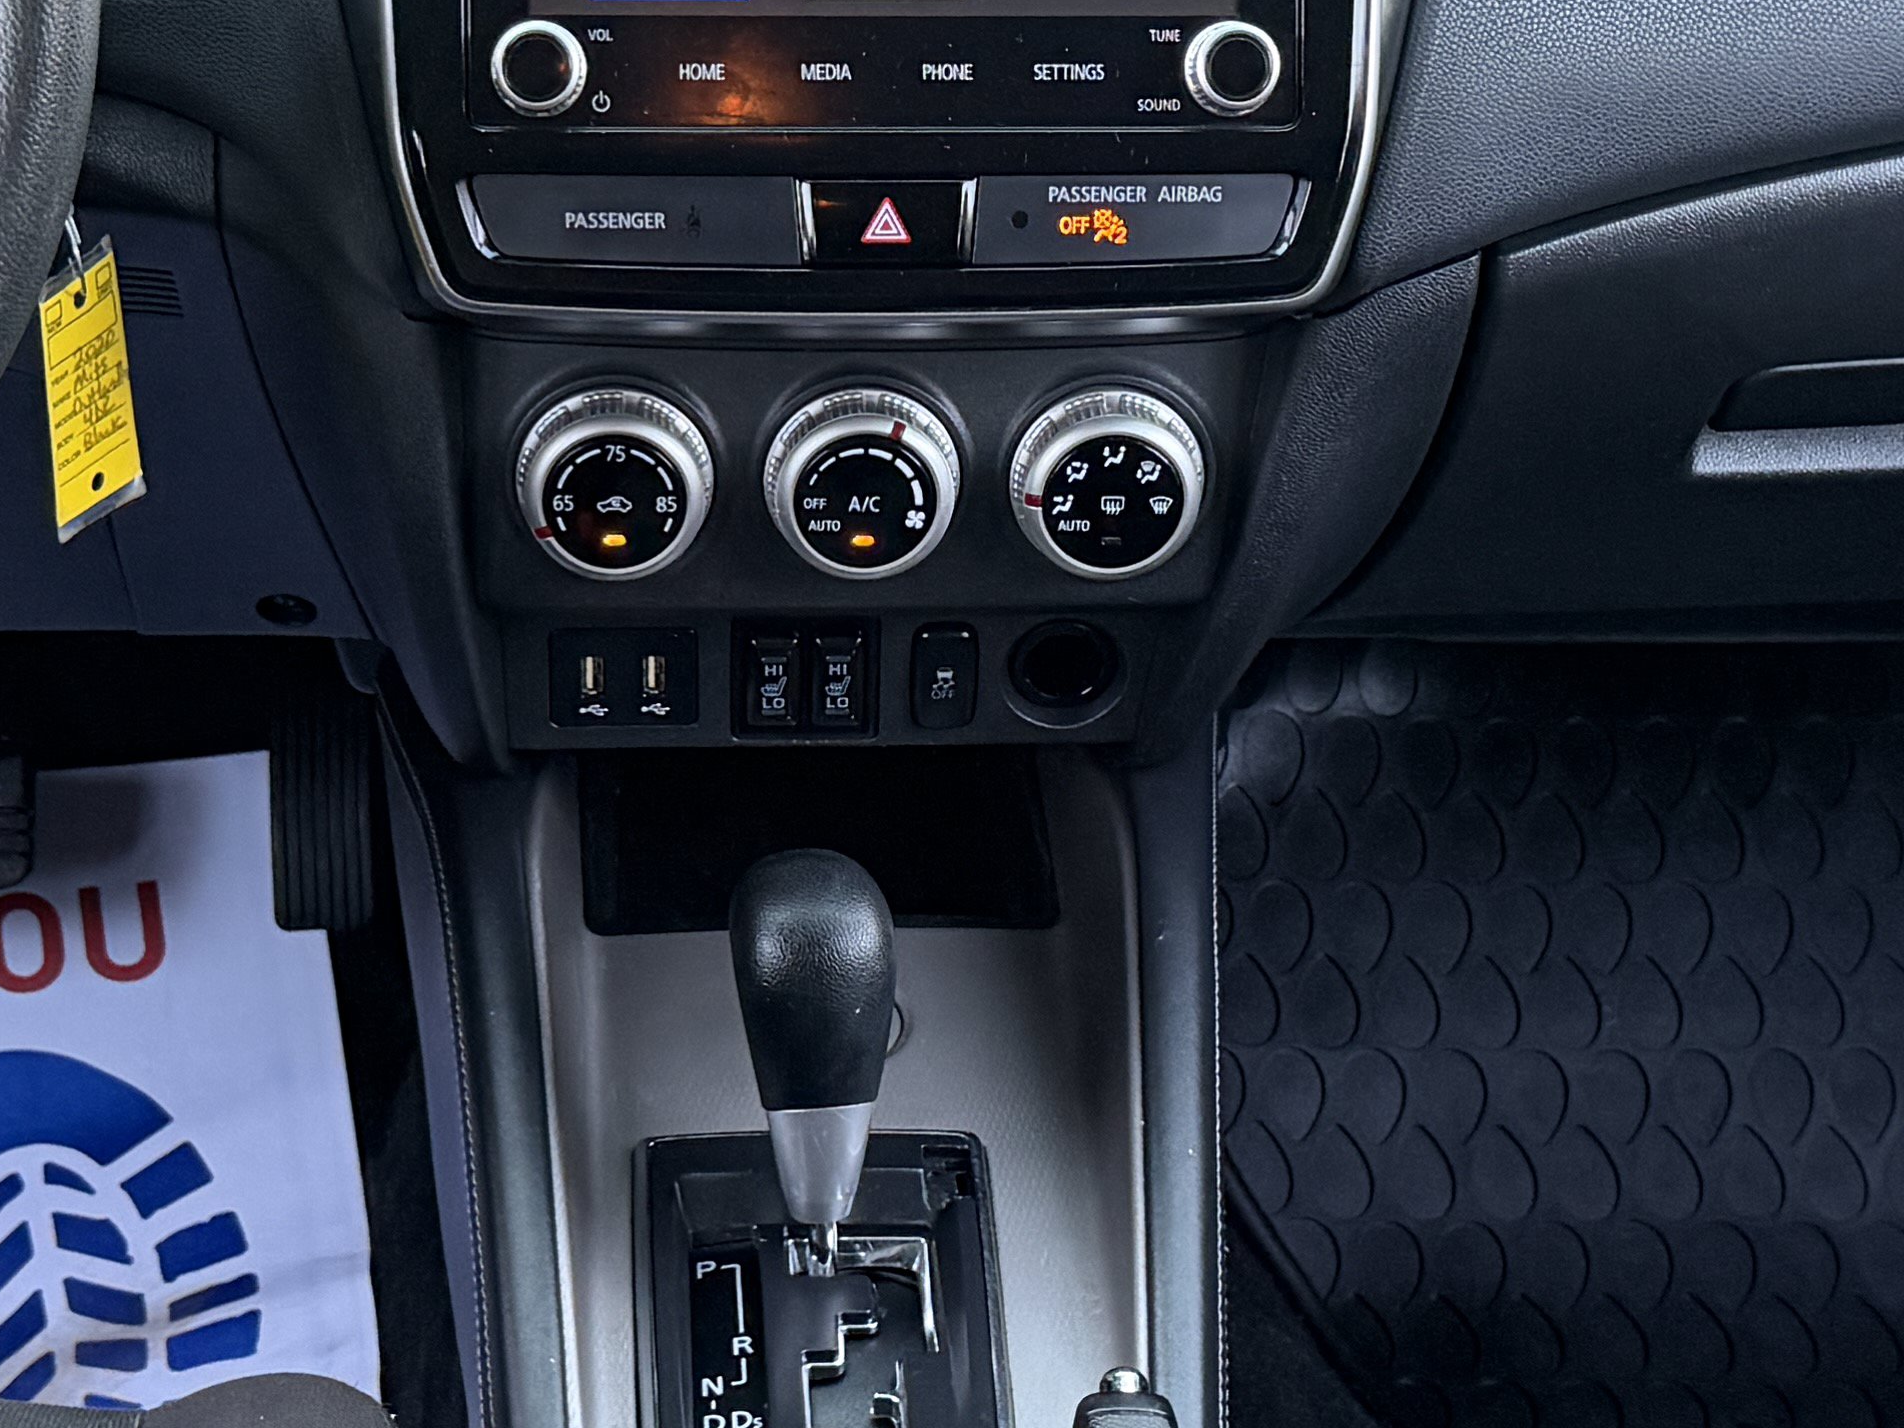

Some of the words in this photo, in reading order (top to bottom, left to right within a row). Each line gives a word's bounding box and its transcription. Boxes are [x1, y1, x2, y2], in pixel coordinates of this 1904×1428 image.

[587, 28, 614, 43] VOL
[1149, 28, 1181, 43] TUNE
[678, 62, 726, 82] HOME
[800, 62, 853, 82] MEDIA
[921, 62, 974, 83] PHONE
[1032, 62, 1105, 83] SETTINGS
[1136, 98, 1181, 113] SOUND
[1048, 185, 1147, 204] PASSENGER
[1157, 185, 1223, 204] AIRBAG
[564, 212, 667, 231] PASSENGER
[1058, 215, 1091, 235] OFF
[605, 446, 627, 464] 75
[552, 496, 574, 512] 65
[655, 496, 678, 512] 85
[803, 497, 827, 510] OFF
[848, 495, 881, 514] A/C
[808, 519, 841, 532] AUTO
[1057, 519, 1090, 532] AUTO
[764, 664, 783, 676] HI
[828, 663, 847, 676] HI
[826, 696, 849, 709] LO
[931, 689, 955, 700] OFF
[762, 697, 786, 709] LO
[696, 1261, 717, 1280] P
[732, 1335, 754, 1356] R
[702, 1377, 724, 1397] N
